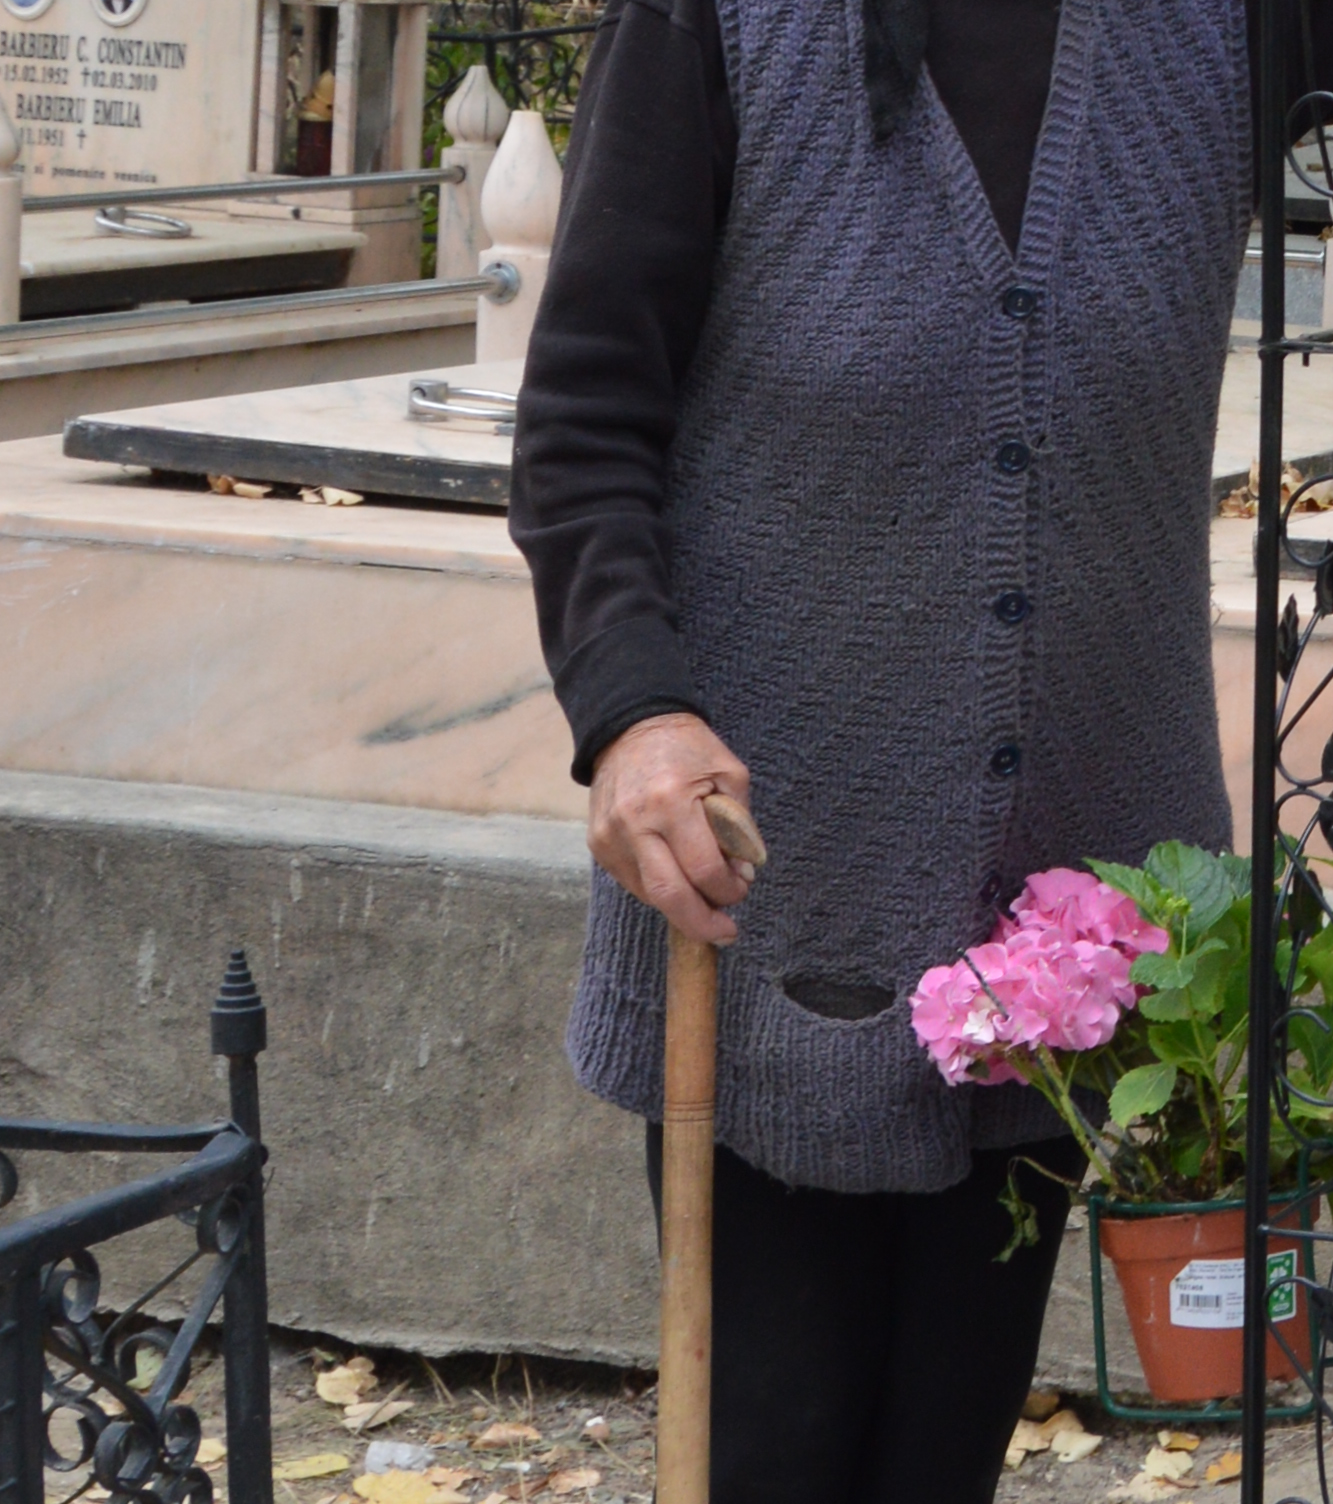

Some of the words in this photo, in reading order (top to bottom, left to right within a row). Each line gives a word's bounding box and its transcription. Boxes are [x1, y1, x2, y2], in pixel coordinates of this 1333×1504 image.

[0, 30, 70, 61] BARBIERU
[97, 37, 188, 70] CONSTANTIN
[16, 93, 87, 124] BARBIERU
[93, 98, 142, 128] EMILIA
